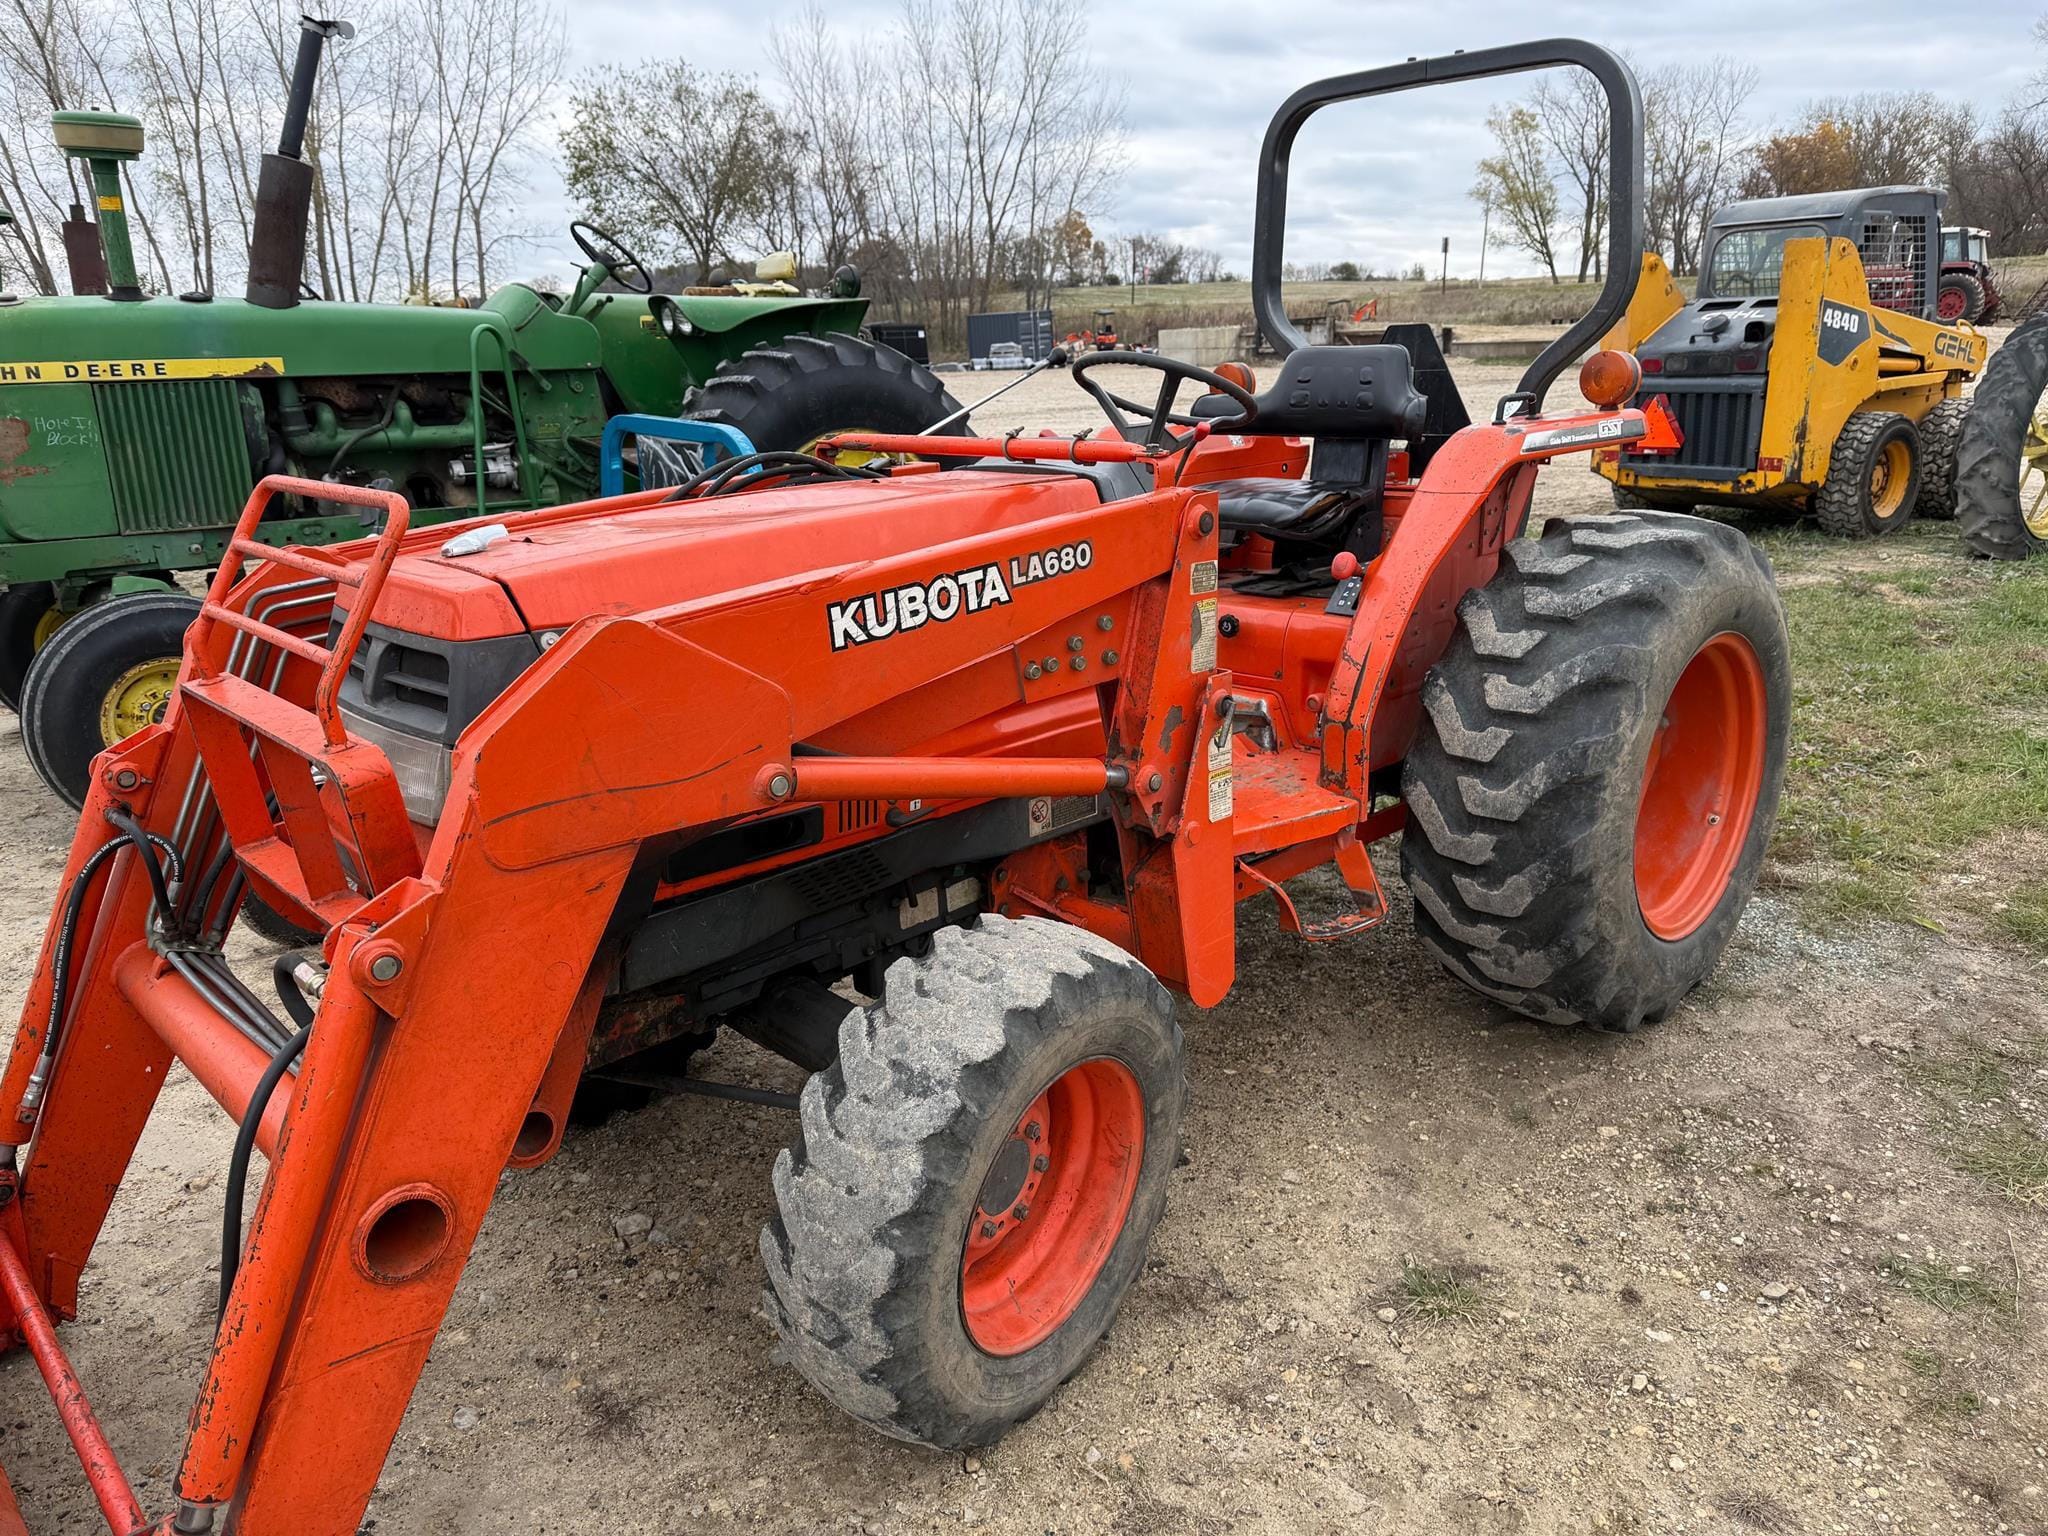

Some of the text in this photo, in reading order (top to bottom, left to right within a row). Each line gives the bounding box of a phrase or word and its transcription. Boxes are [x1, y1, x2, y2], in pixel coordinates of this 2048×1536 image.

[1823, 307, 1859, 333] 4840
[1934, 331, 1977, 364] GEHL
[0, 362, 168, 381] HN DEERE
[34, 416, 70, 433] Hole
[1599, 418, 1624, 438] GST
[1009, 540, 1093, 588] LA680
[828, 563, 1012, 651] KUBOTA
